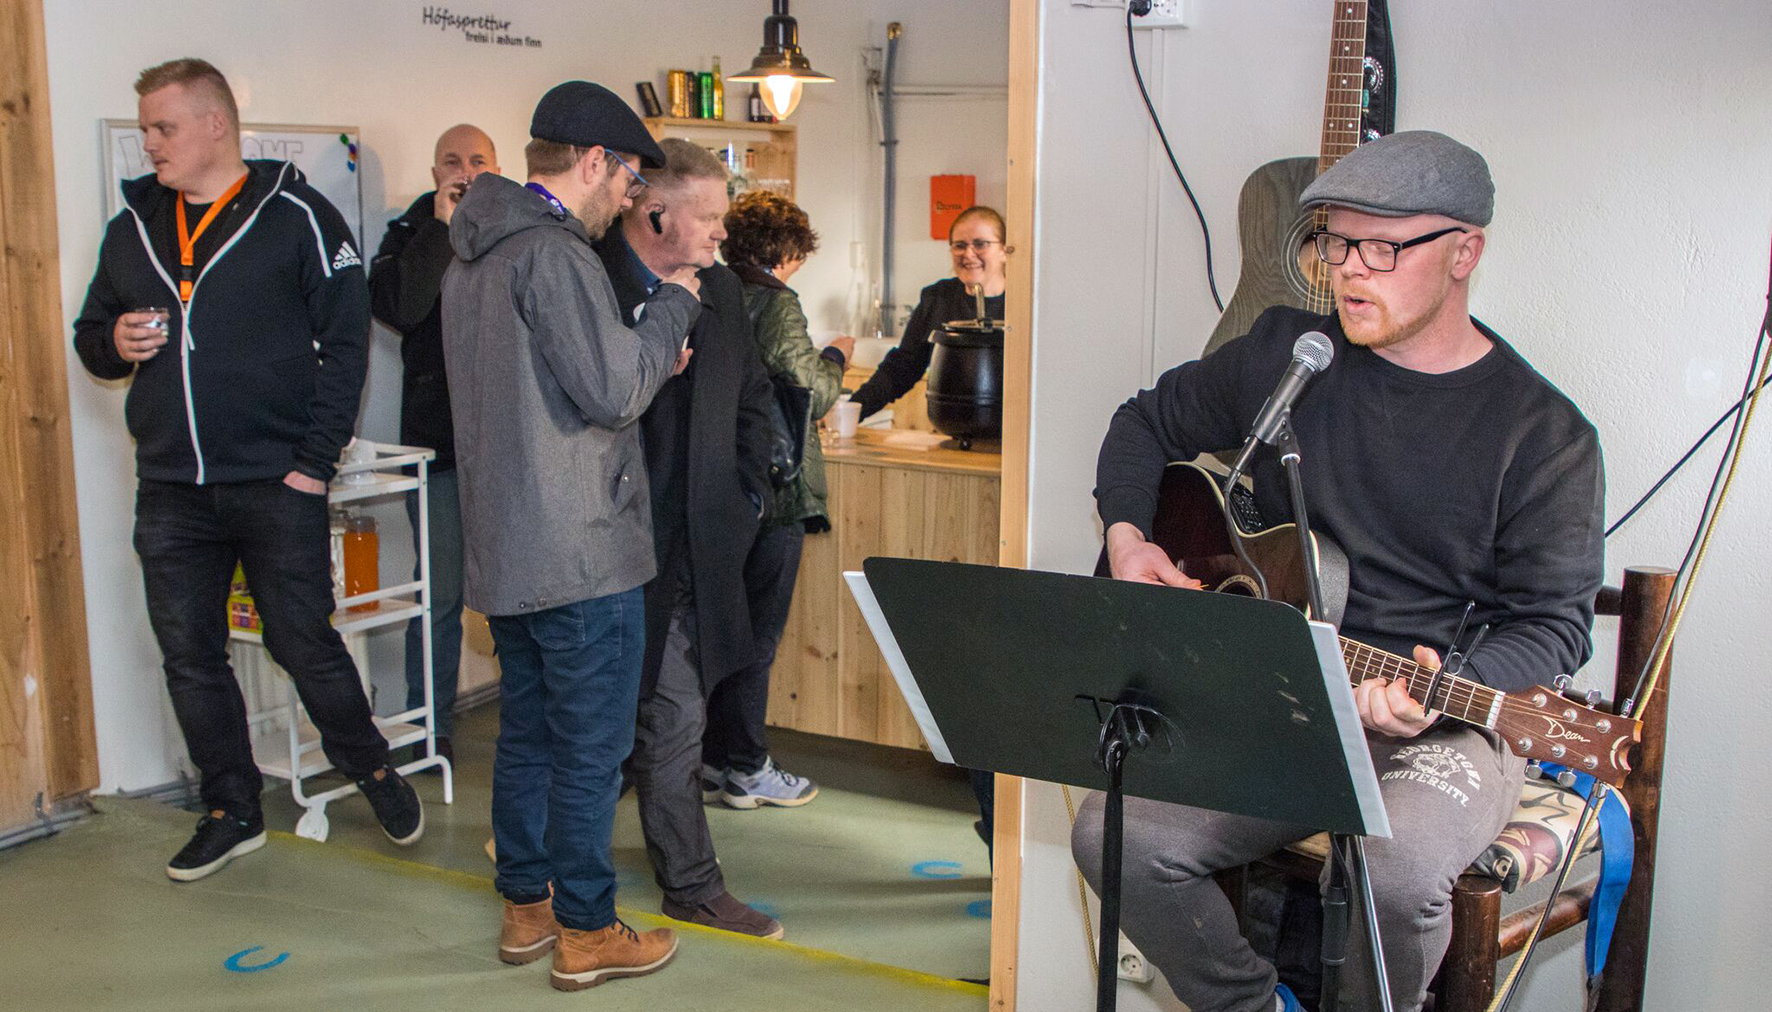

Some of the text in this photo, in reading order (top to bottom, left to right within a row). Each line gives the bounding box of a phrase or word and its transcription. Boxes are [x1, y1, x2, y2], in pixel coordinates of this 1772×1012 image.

[422, 5, 511, 32] Hófasprettur
[332, 256, 362, 270] adidas
[1542, 715, 1591, 743] Dean
[1381, 770, 1470, 807] UNIVERSITY
